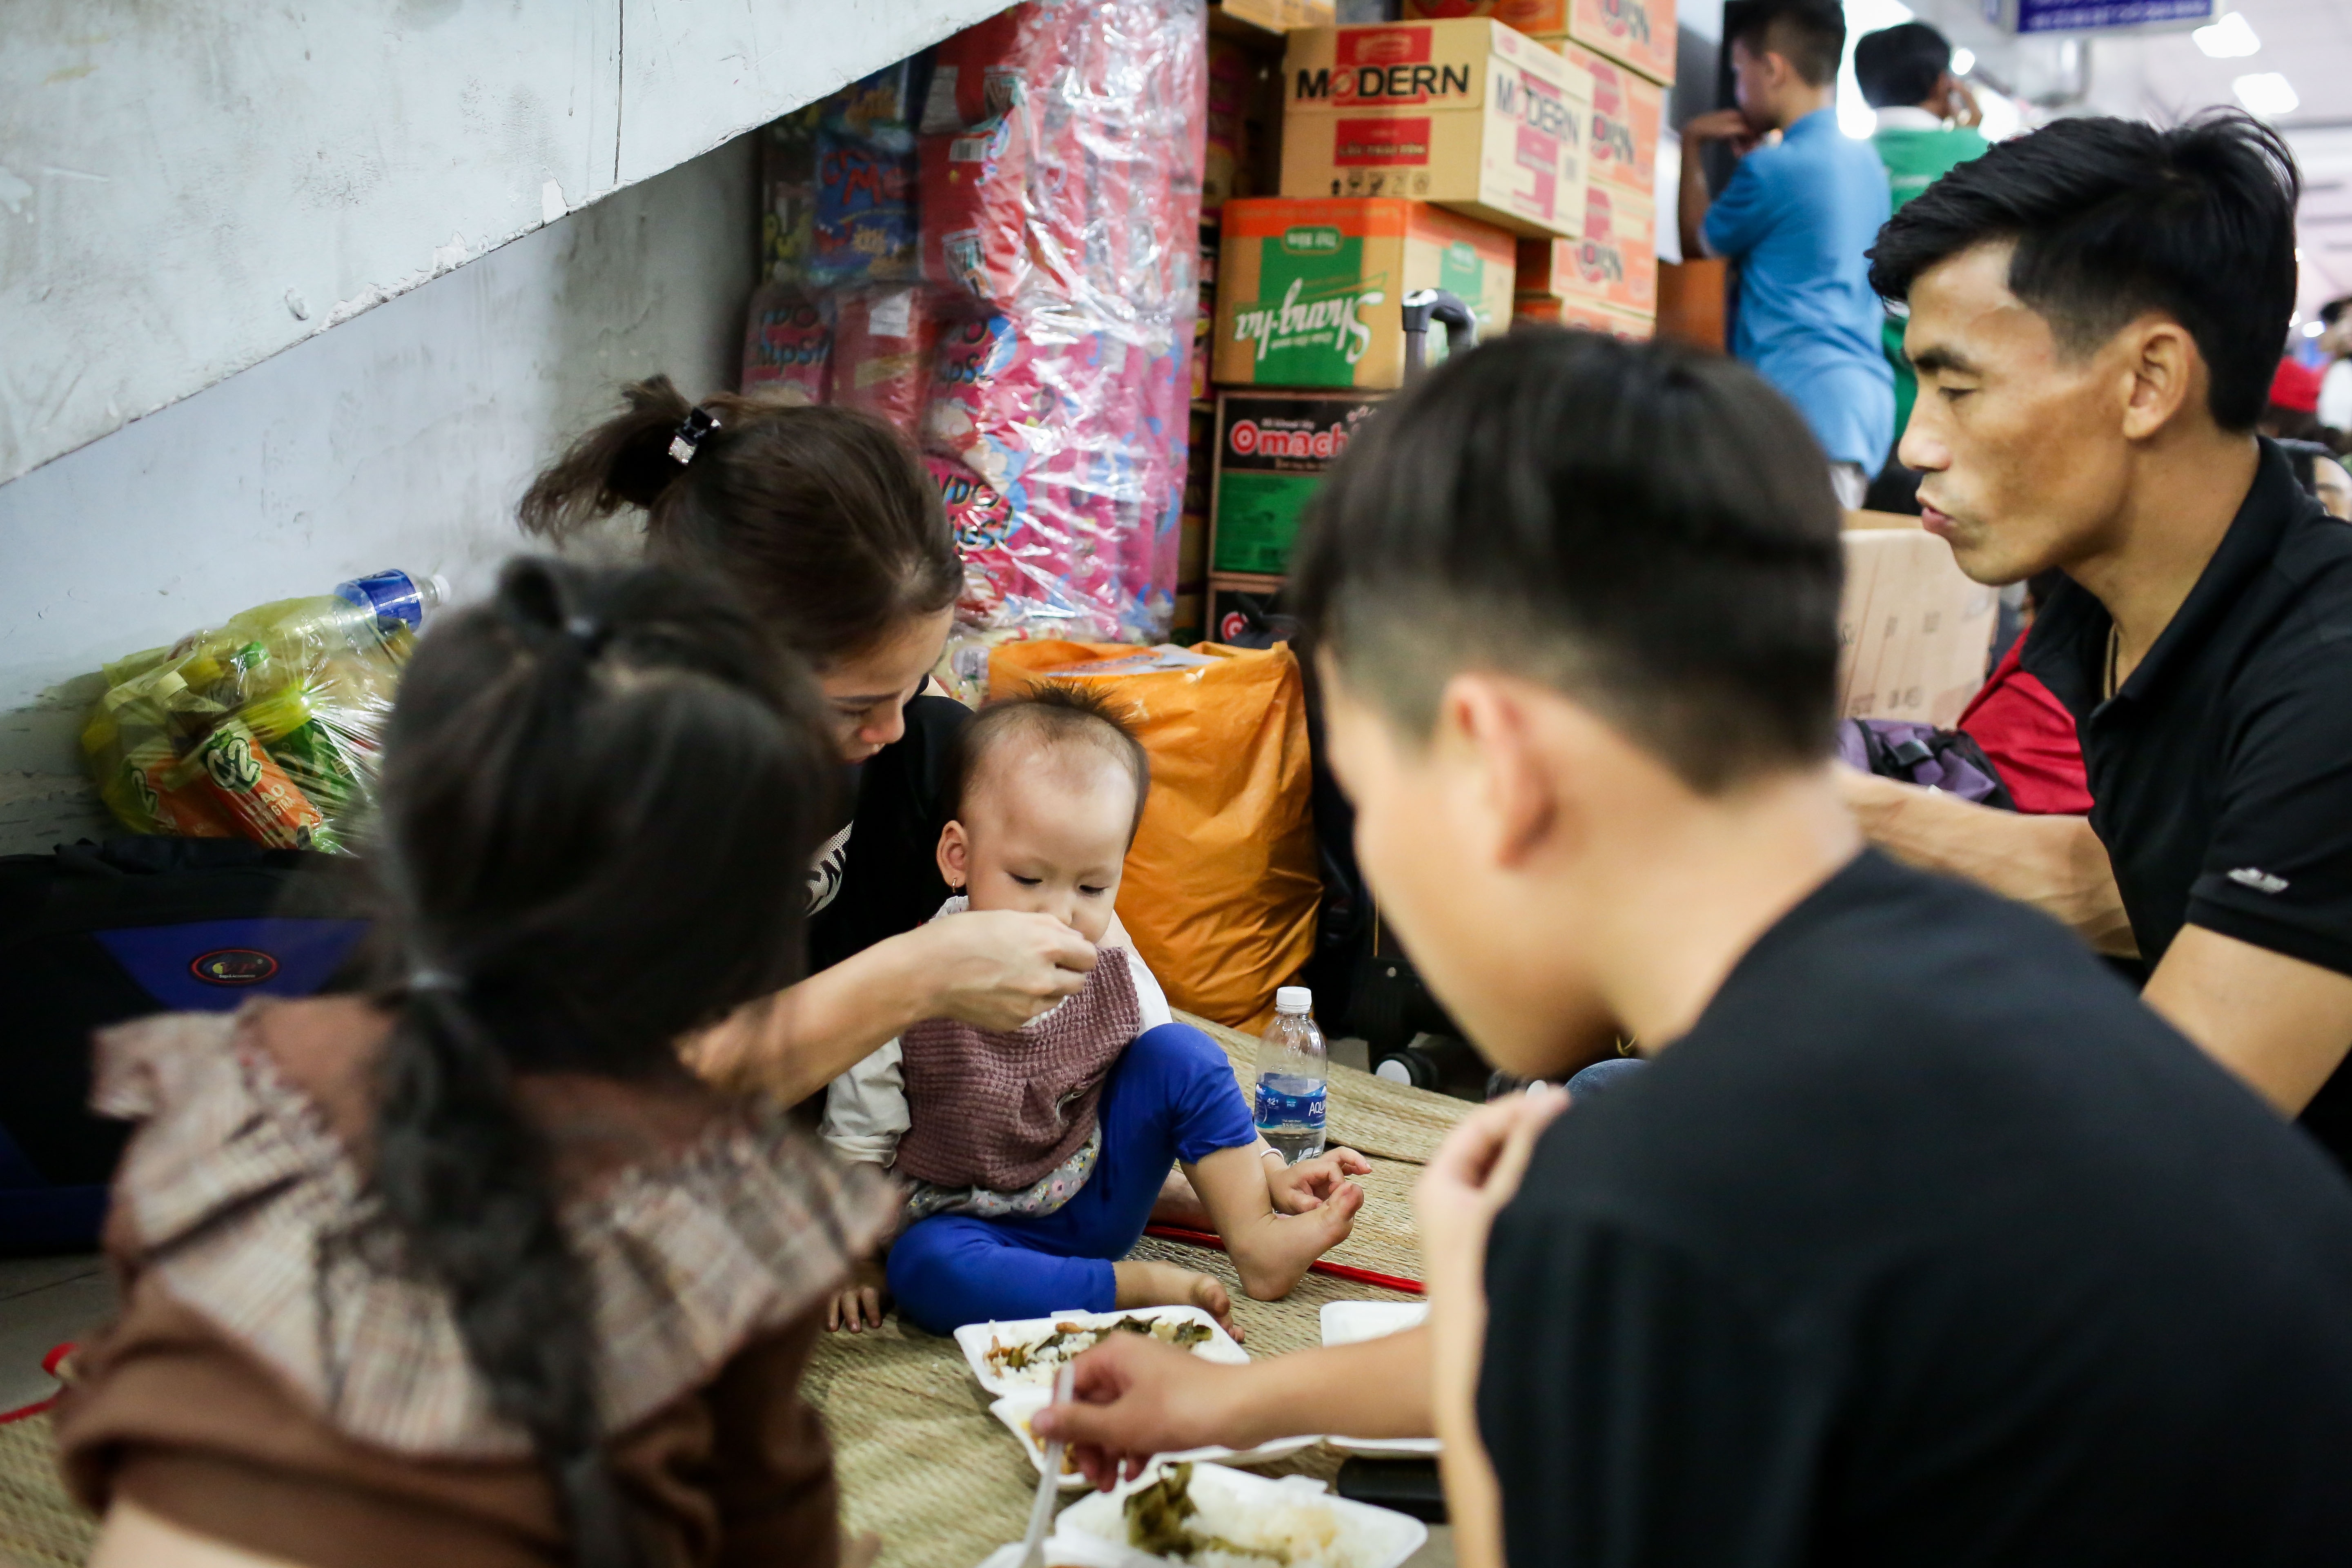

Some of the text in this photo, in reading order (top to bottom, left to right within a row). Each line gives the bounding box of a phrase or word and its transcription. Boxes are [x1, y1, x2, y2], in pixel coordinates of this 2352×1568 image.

[1296, 62, 1470, 99] MODERN
[1495, 72, 1580, 147] MODERN
[1229, 419, 1348, 458] Omach
[206, 737, 260, 788] C2
